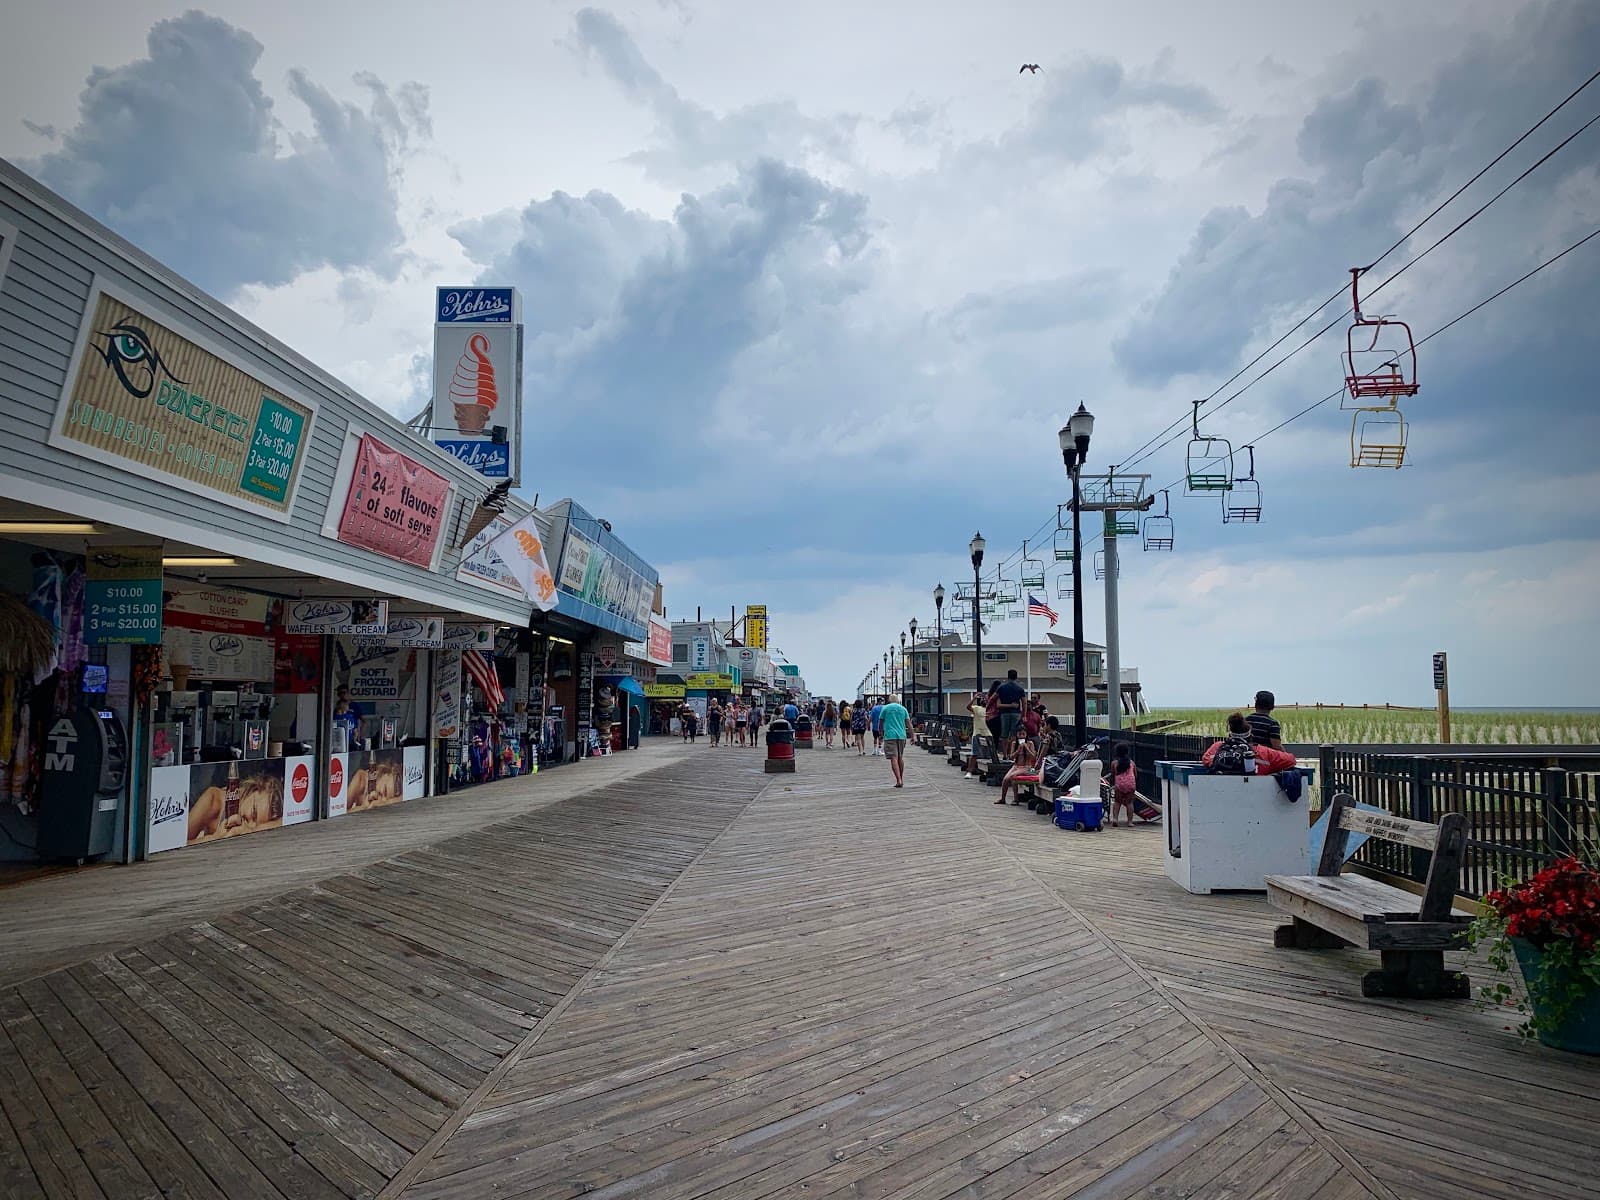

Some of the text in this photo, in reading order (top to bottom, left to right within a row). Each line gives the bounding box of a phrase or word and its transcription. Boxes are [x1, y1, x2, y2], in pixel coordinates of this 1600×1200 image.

[69, 399, 166, 456] SUNDRESSES
[270, 411, 292, 434] $10.00
[255, 428, 262, 445] 2
[262, 433, 273, 447] Pair
[273, 436, 294, 459] $15.00
[249, 449, 290, 480] 3 Pair $20.00
[371, 471, 387, 495] 24
[400, 486, 438, 519] flavors
[367, 498, 380, 513] of
[384, 506, 405, 526] soft
[407, 517, 432, 536] serve
[106, 587, 143, 598] $10.00
[91, 603, 100, 615] 2
[118, 603, 157, 615] $15.00
[90, 618, 157, 630] 3 Pair $20.00
[287, 624, 325, 634] WAFFLES
[339, 624, 352, 634] ICE
[355, 624, 385, 634] CREAM
[351, 638, 386, 646] CUSTARD
[415, 639, 441, 647] CREAM
[360, 668, 387, 677] SOFT
[353, 678, 394, 687] FROZEN
[350, 687, 397, 696] CUSTARD
[44, 718, 79, 773] ATM
